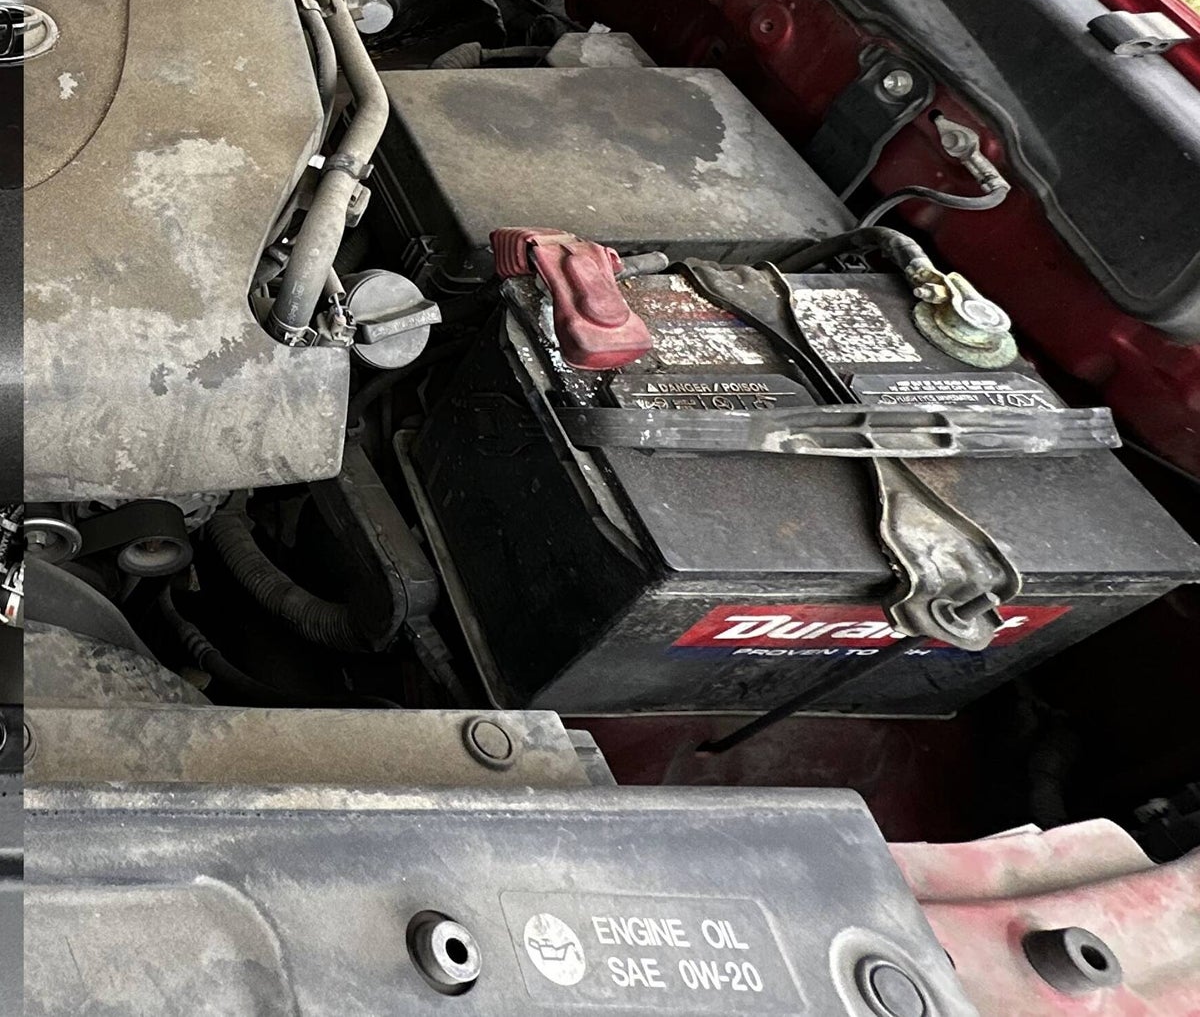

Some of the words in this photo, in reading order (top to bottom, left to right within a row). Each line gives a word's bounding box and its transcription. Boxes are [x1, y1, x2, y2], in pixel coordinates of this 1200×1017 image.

[658, 382, 712, 393] DANGER
[721, 382, 770, 393] POISON
[731, 648, 840, 656] PROVEN
[845, 648, 880, 656] TO
[591, 915, 692, 948] ENGINE
[701, 918, 750, 950] OIL
[607, 956, 667, 989] SAE
[678, 958, 764, 992] 0W-20
